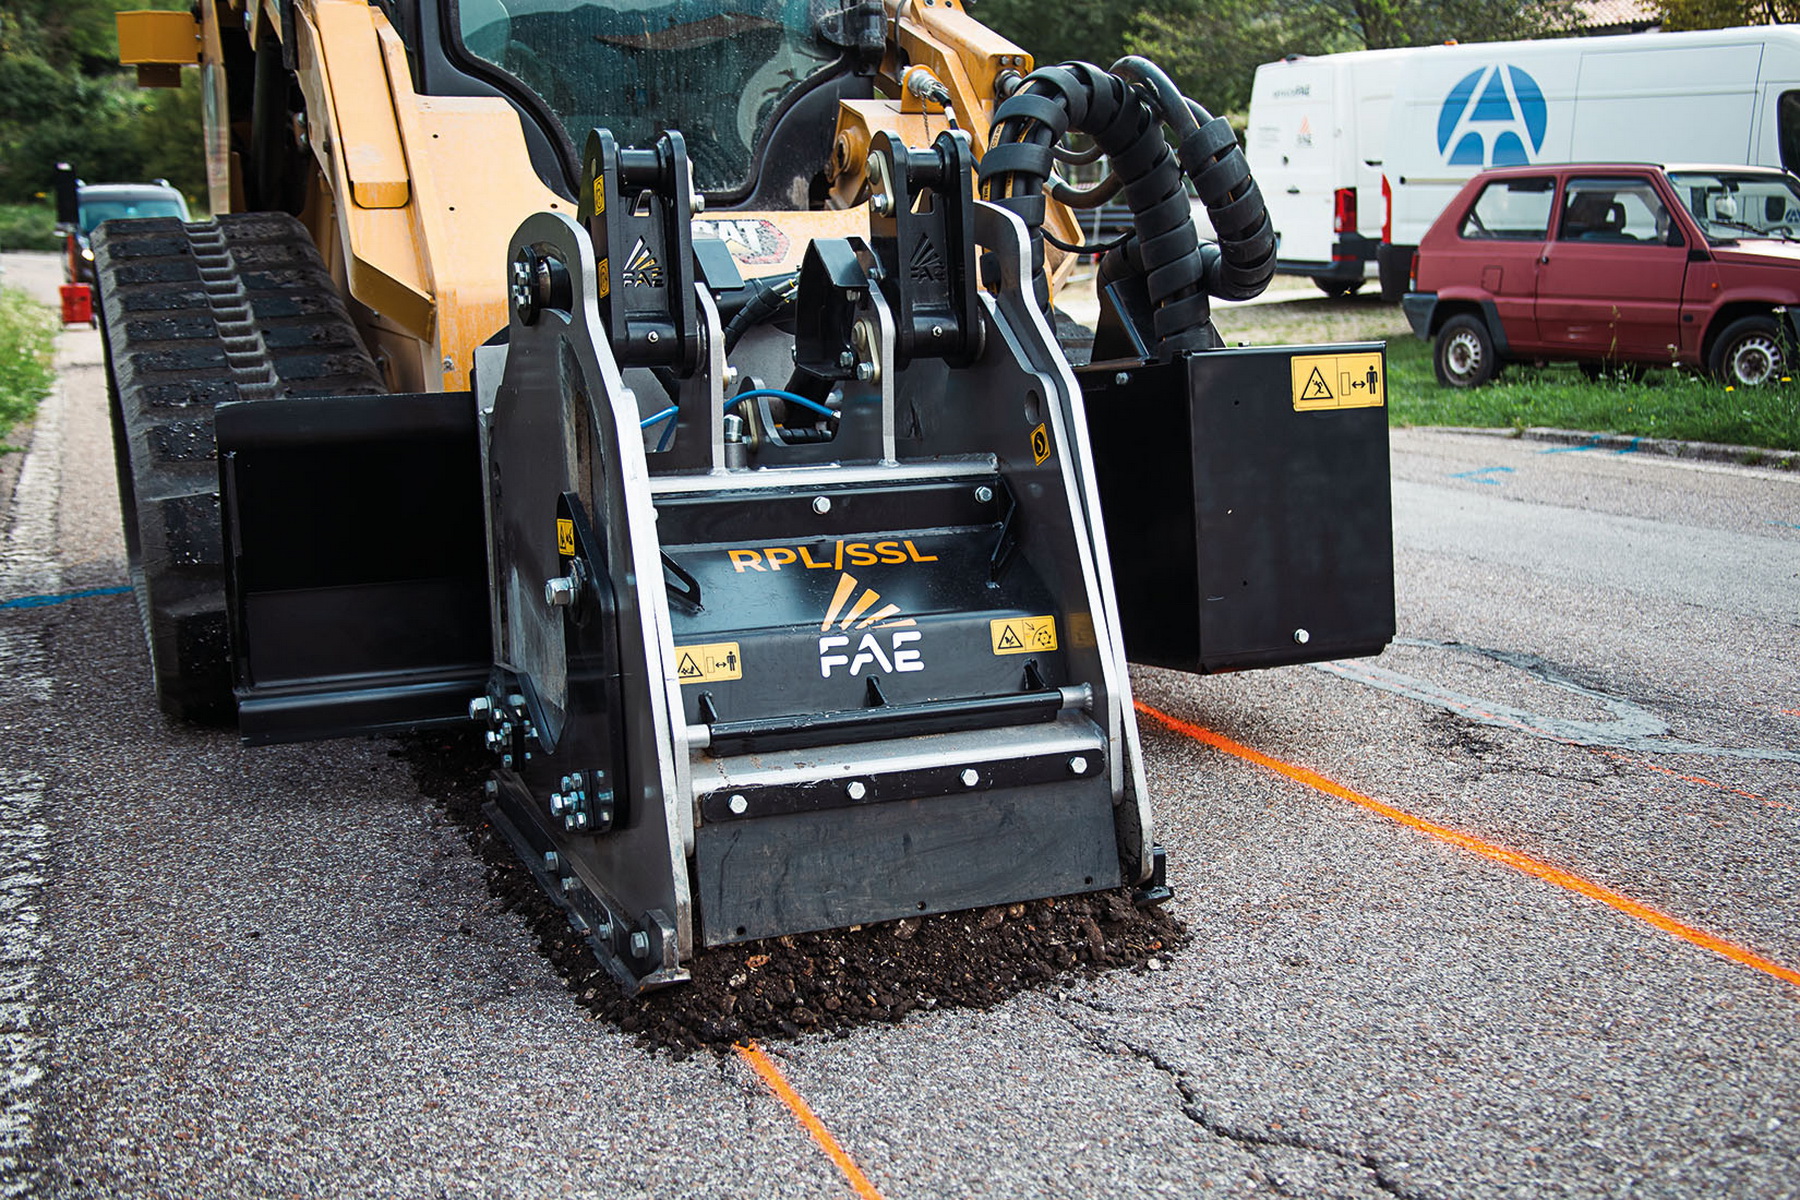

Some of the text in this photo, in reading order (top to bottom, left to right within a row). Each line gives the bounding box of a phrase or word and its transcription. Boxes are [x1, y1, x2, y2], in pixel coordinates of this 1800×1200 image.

[622, 271, 664, 288] FAE
[727, 540, 939, 573] RPL/SSL
[818, 630, 925, 678] FAE
